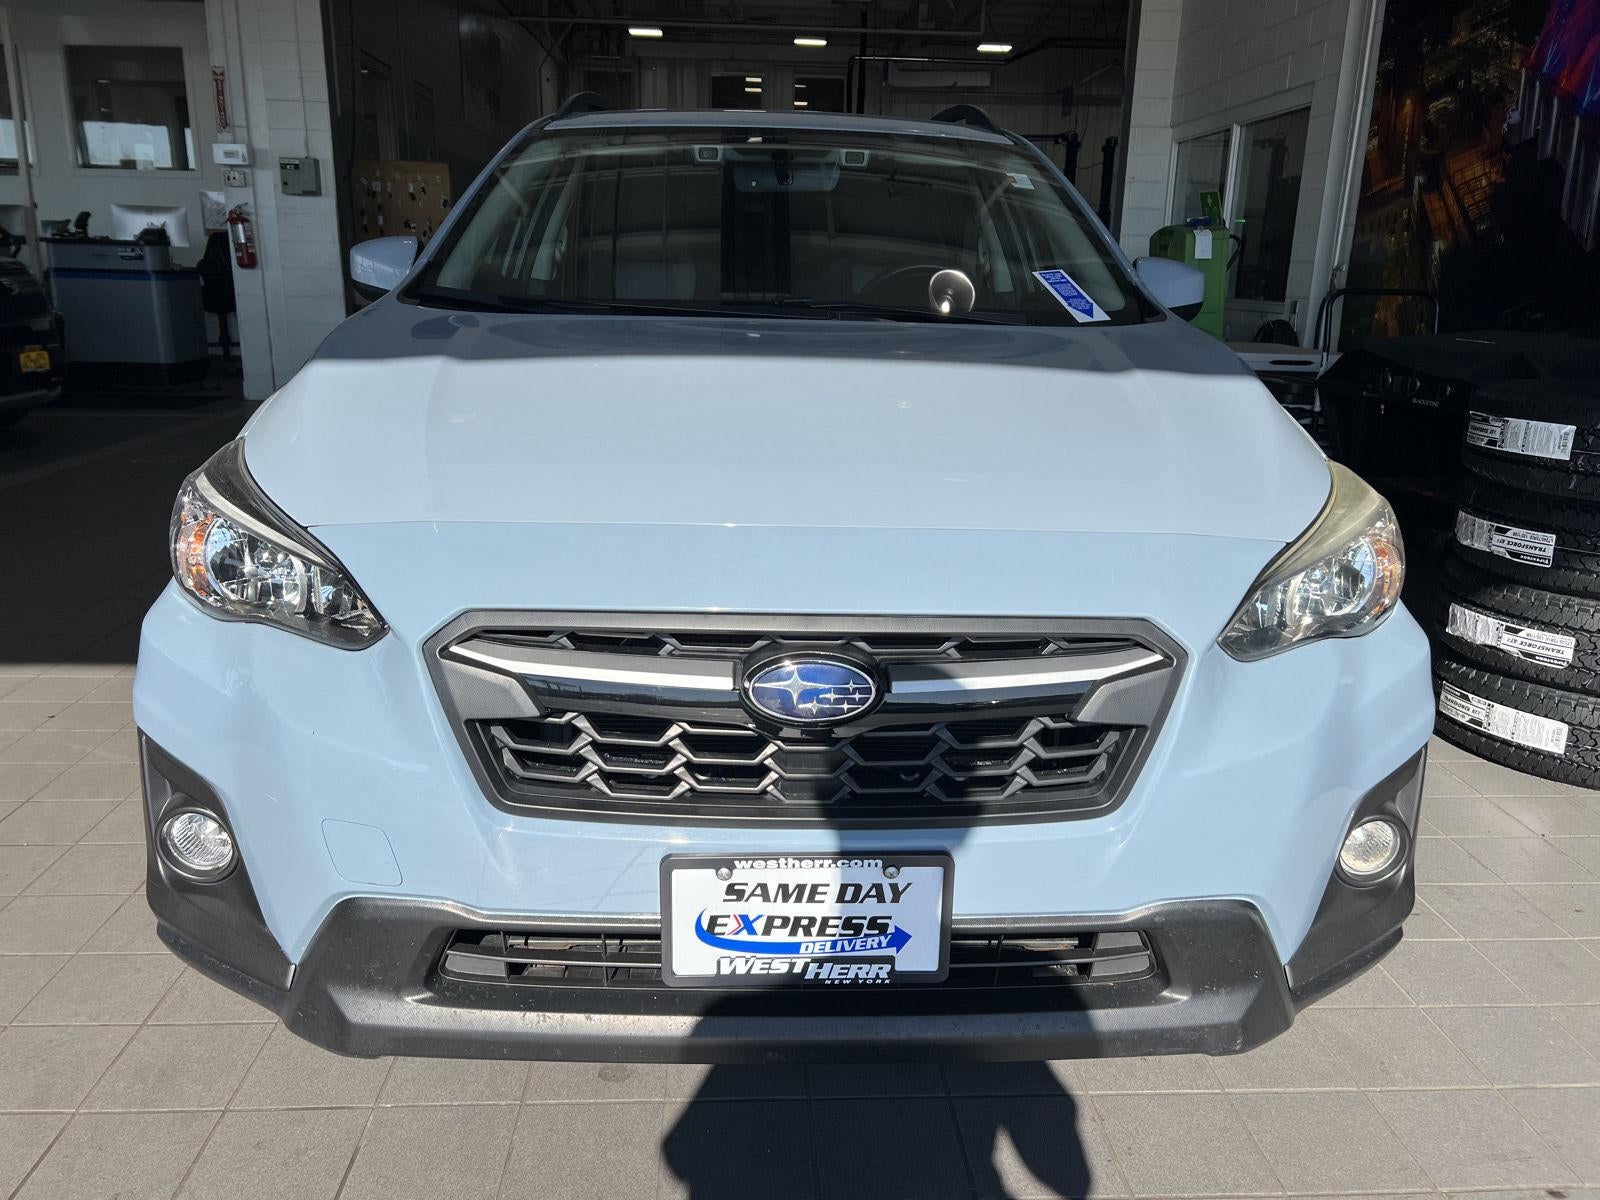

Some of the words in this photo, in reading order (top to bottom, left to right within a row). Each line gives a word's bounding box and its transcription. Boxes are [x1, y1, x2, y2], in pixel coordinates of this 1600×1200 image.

[1506, 540, 1547, 553] TRANSFORCE
[1518, 640, 1565, 655] TRANSFORCE
[733, 858, 883, 870] westherr.com
[722, 882, 831, 904] SAME
[835, 882, 913, 904] DAY
[705, 914, 893, 938] EXPRESS
[799, 935, 893, 955] DELIVERY
[718, 956, 812, 976] WEST
[804, 963, 892, 980] HERR
